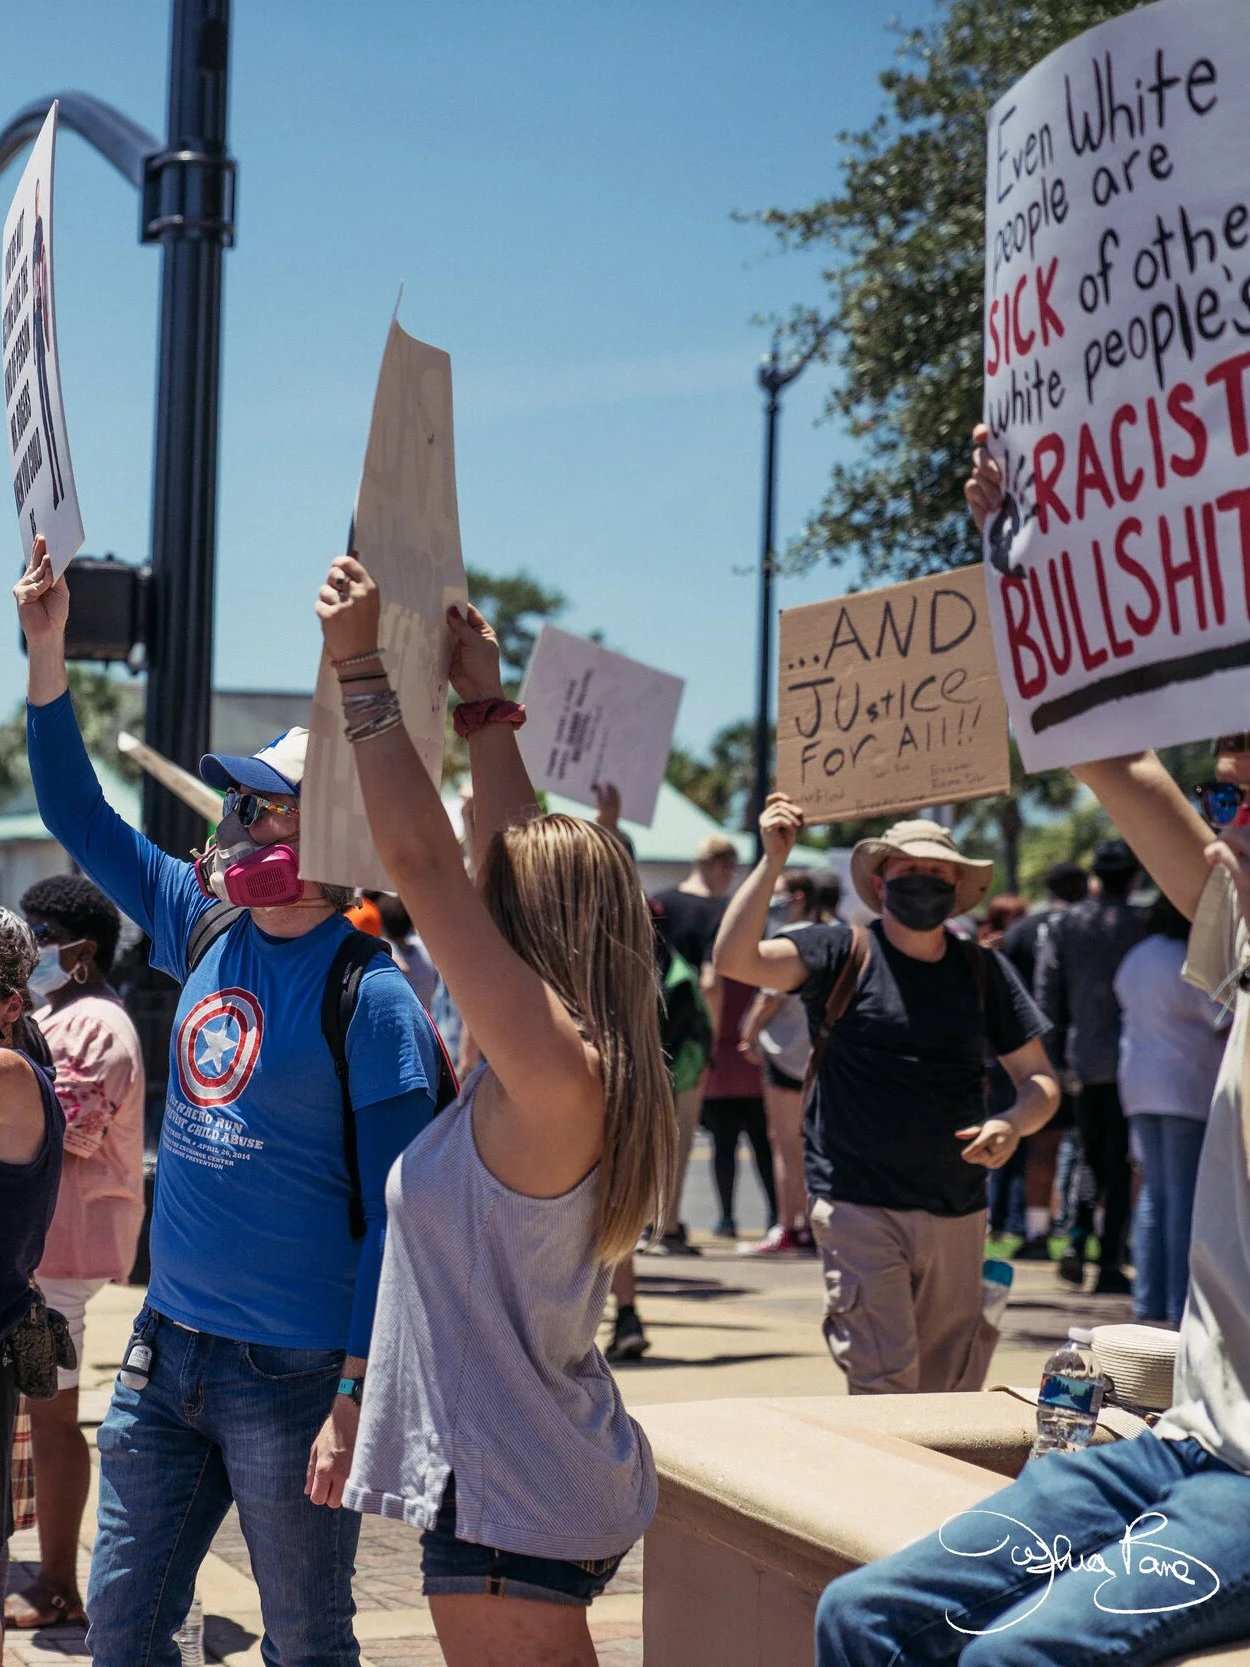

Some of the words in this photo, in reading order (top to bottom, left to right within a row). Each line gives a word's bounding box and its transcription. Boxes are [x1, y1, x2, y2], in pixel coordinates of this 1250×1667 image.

[996, 104, 1053, 204] Even
[1064, 48, 1218, 157] White
[993, 176, 1069, 297] people
[1092, 142, 1174, 207] are
[987, 256, 1065, 377] SICK
[1079, 228, 1120, 313] of
[1133, 204, 1249, 290] othe
[989, 358, 1066, 440] white
[1033, 351, 1250, 535] RACIST
[1001, 487, 1250, 700] BULLSHIT
[185, 1154, 224, 1170] PREVENTION
[188, 1123, 219, 1141] CHILD
[221, 1131, 264, 1150] ABUSE
[197, 1142, 220, 1153] APRIL
[232, 1151, 251, 1161] 2014
[207, 1154, 235, 1166] CENTER
[215, 1117, 243, 1134] RUN
